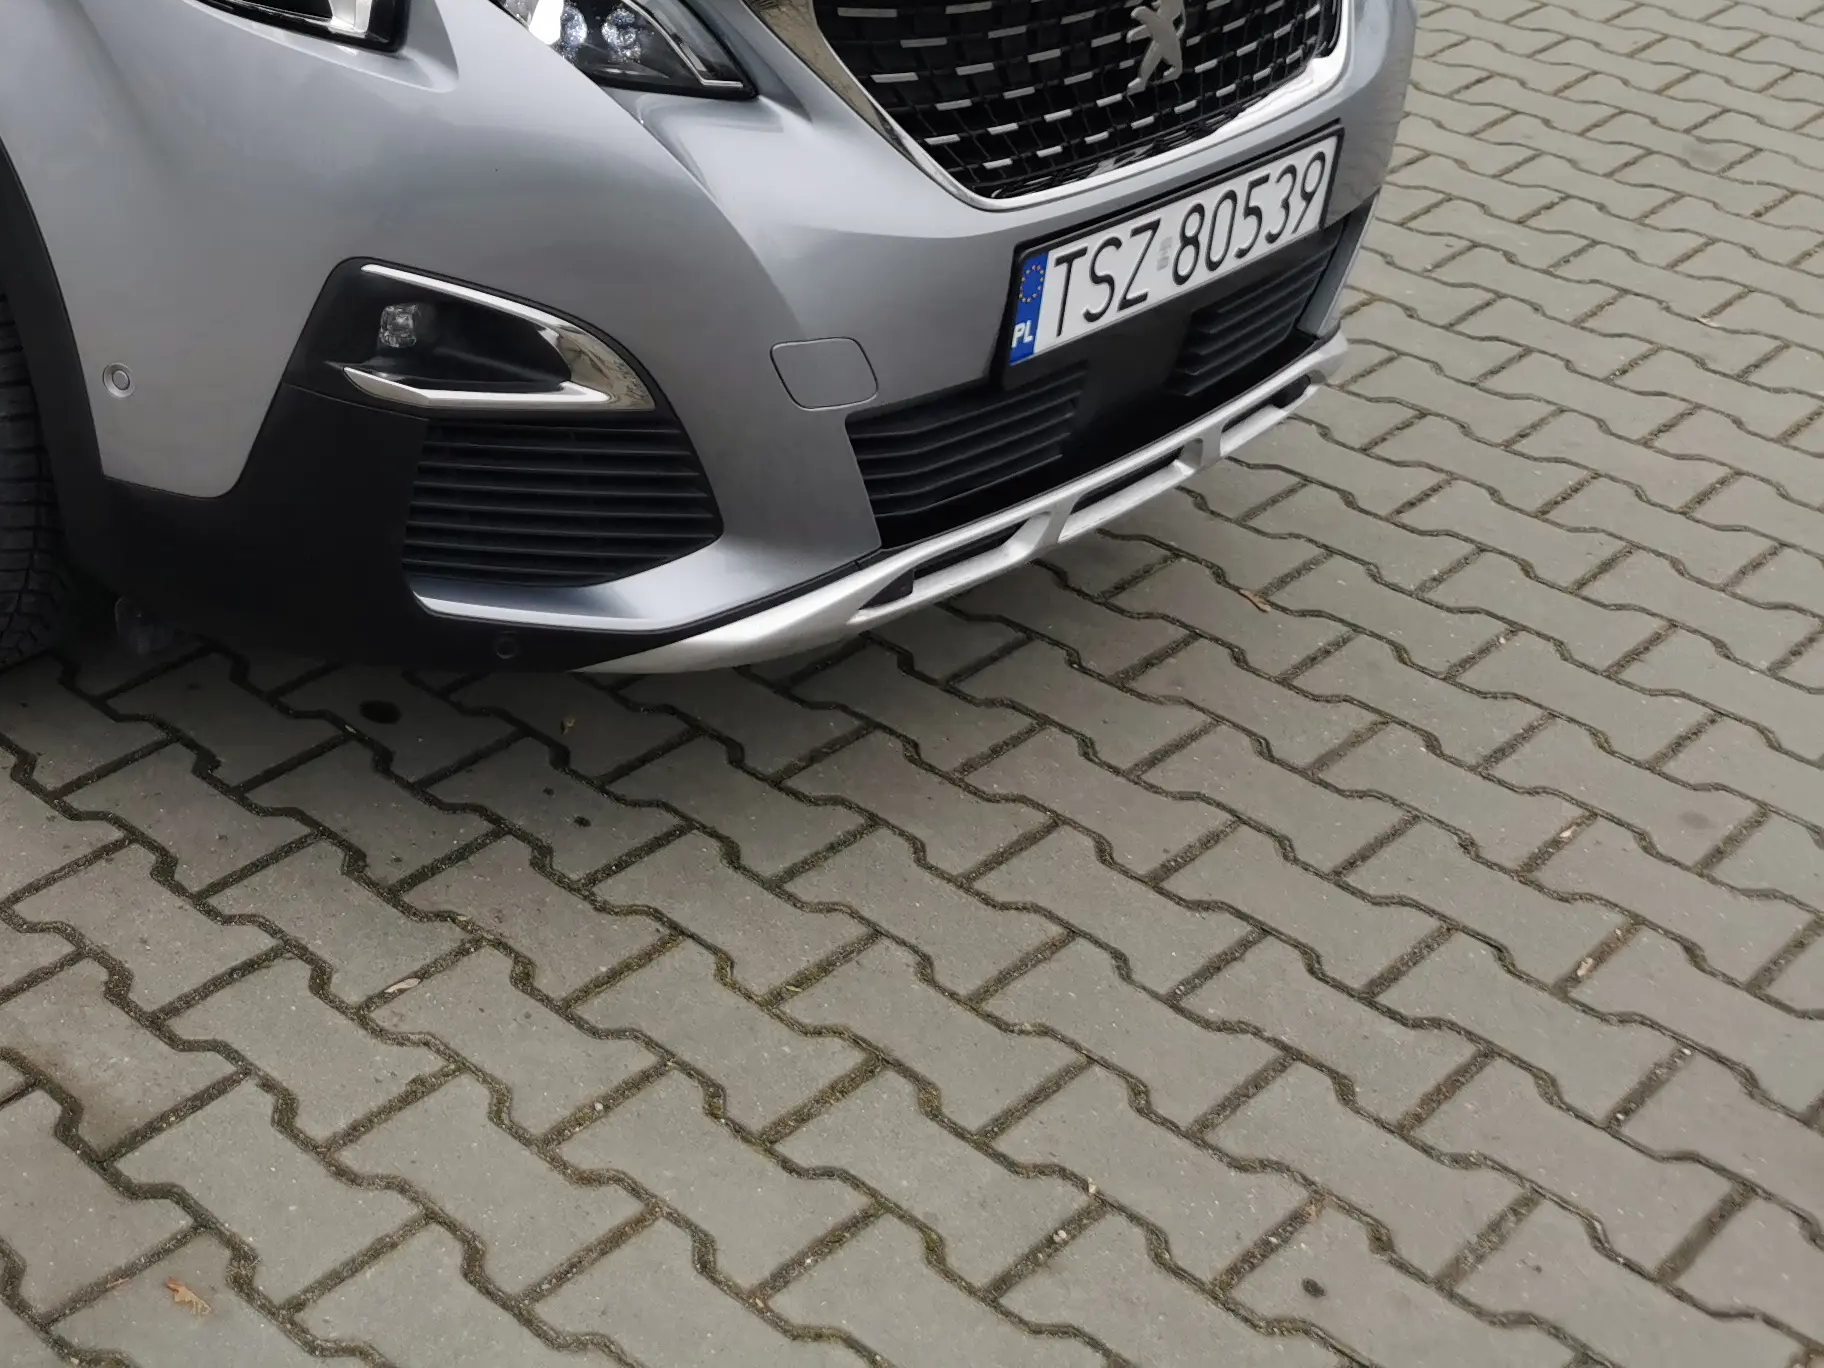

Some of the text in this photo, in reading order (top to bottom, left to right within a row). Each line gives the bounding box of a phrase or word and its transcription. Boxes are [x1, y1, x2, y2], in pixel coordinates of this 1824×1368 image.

[1054, 151, 1326, 337] TSZ 80539
[1011, 319, 1034, 349] PL
